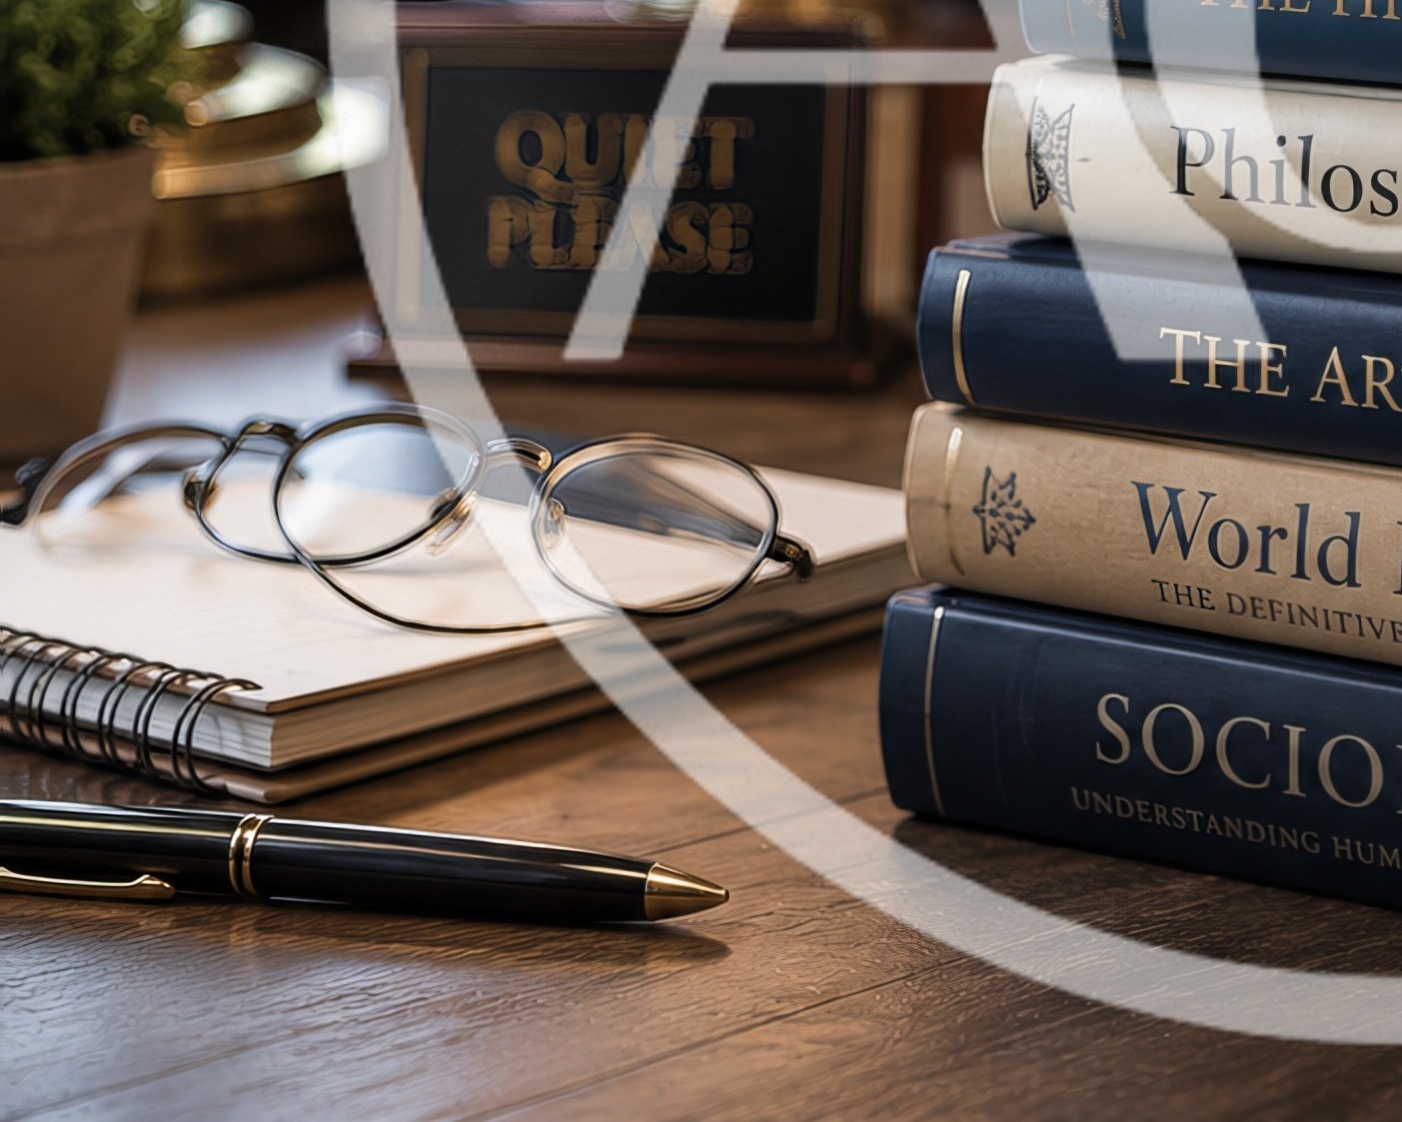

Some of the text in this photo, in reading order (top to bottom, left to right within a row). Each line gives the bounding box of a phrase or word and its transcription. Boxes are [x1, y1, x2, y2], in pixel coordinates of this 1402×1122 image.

[1159, 326, 1290, 397] THE
[1130, 480, 1362, 588] World
[1151, 578, 1216, 611] THE
[1072, 786, 1321, 854] UNDERSTANDING
